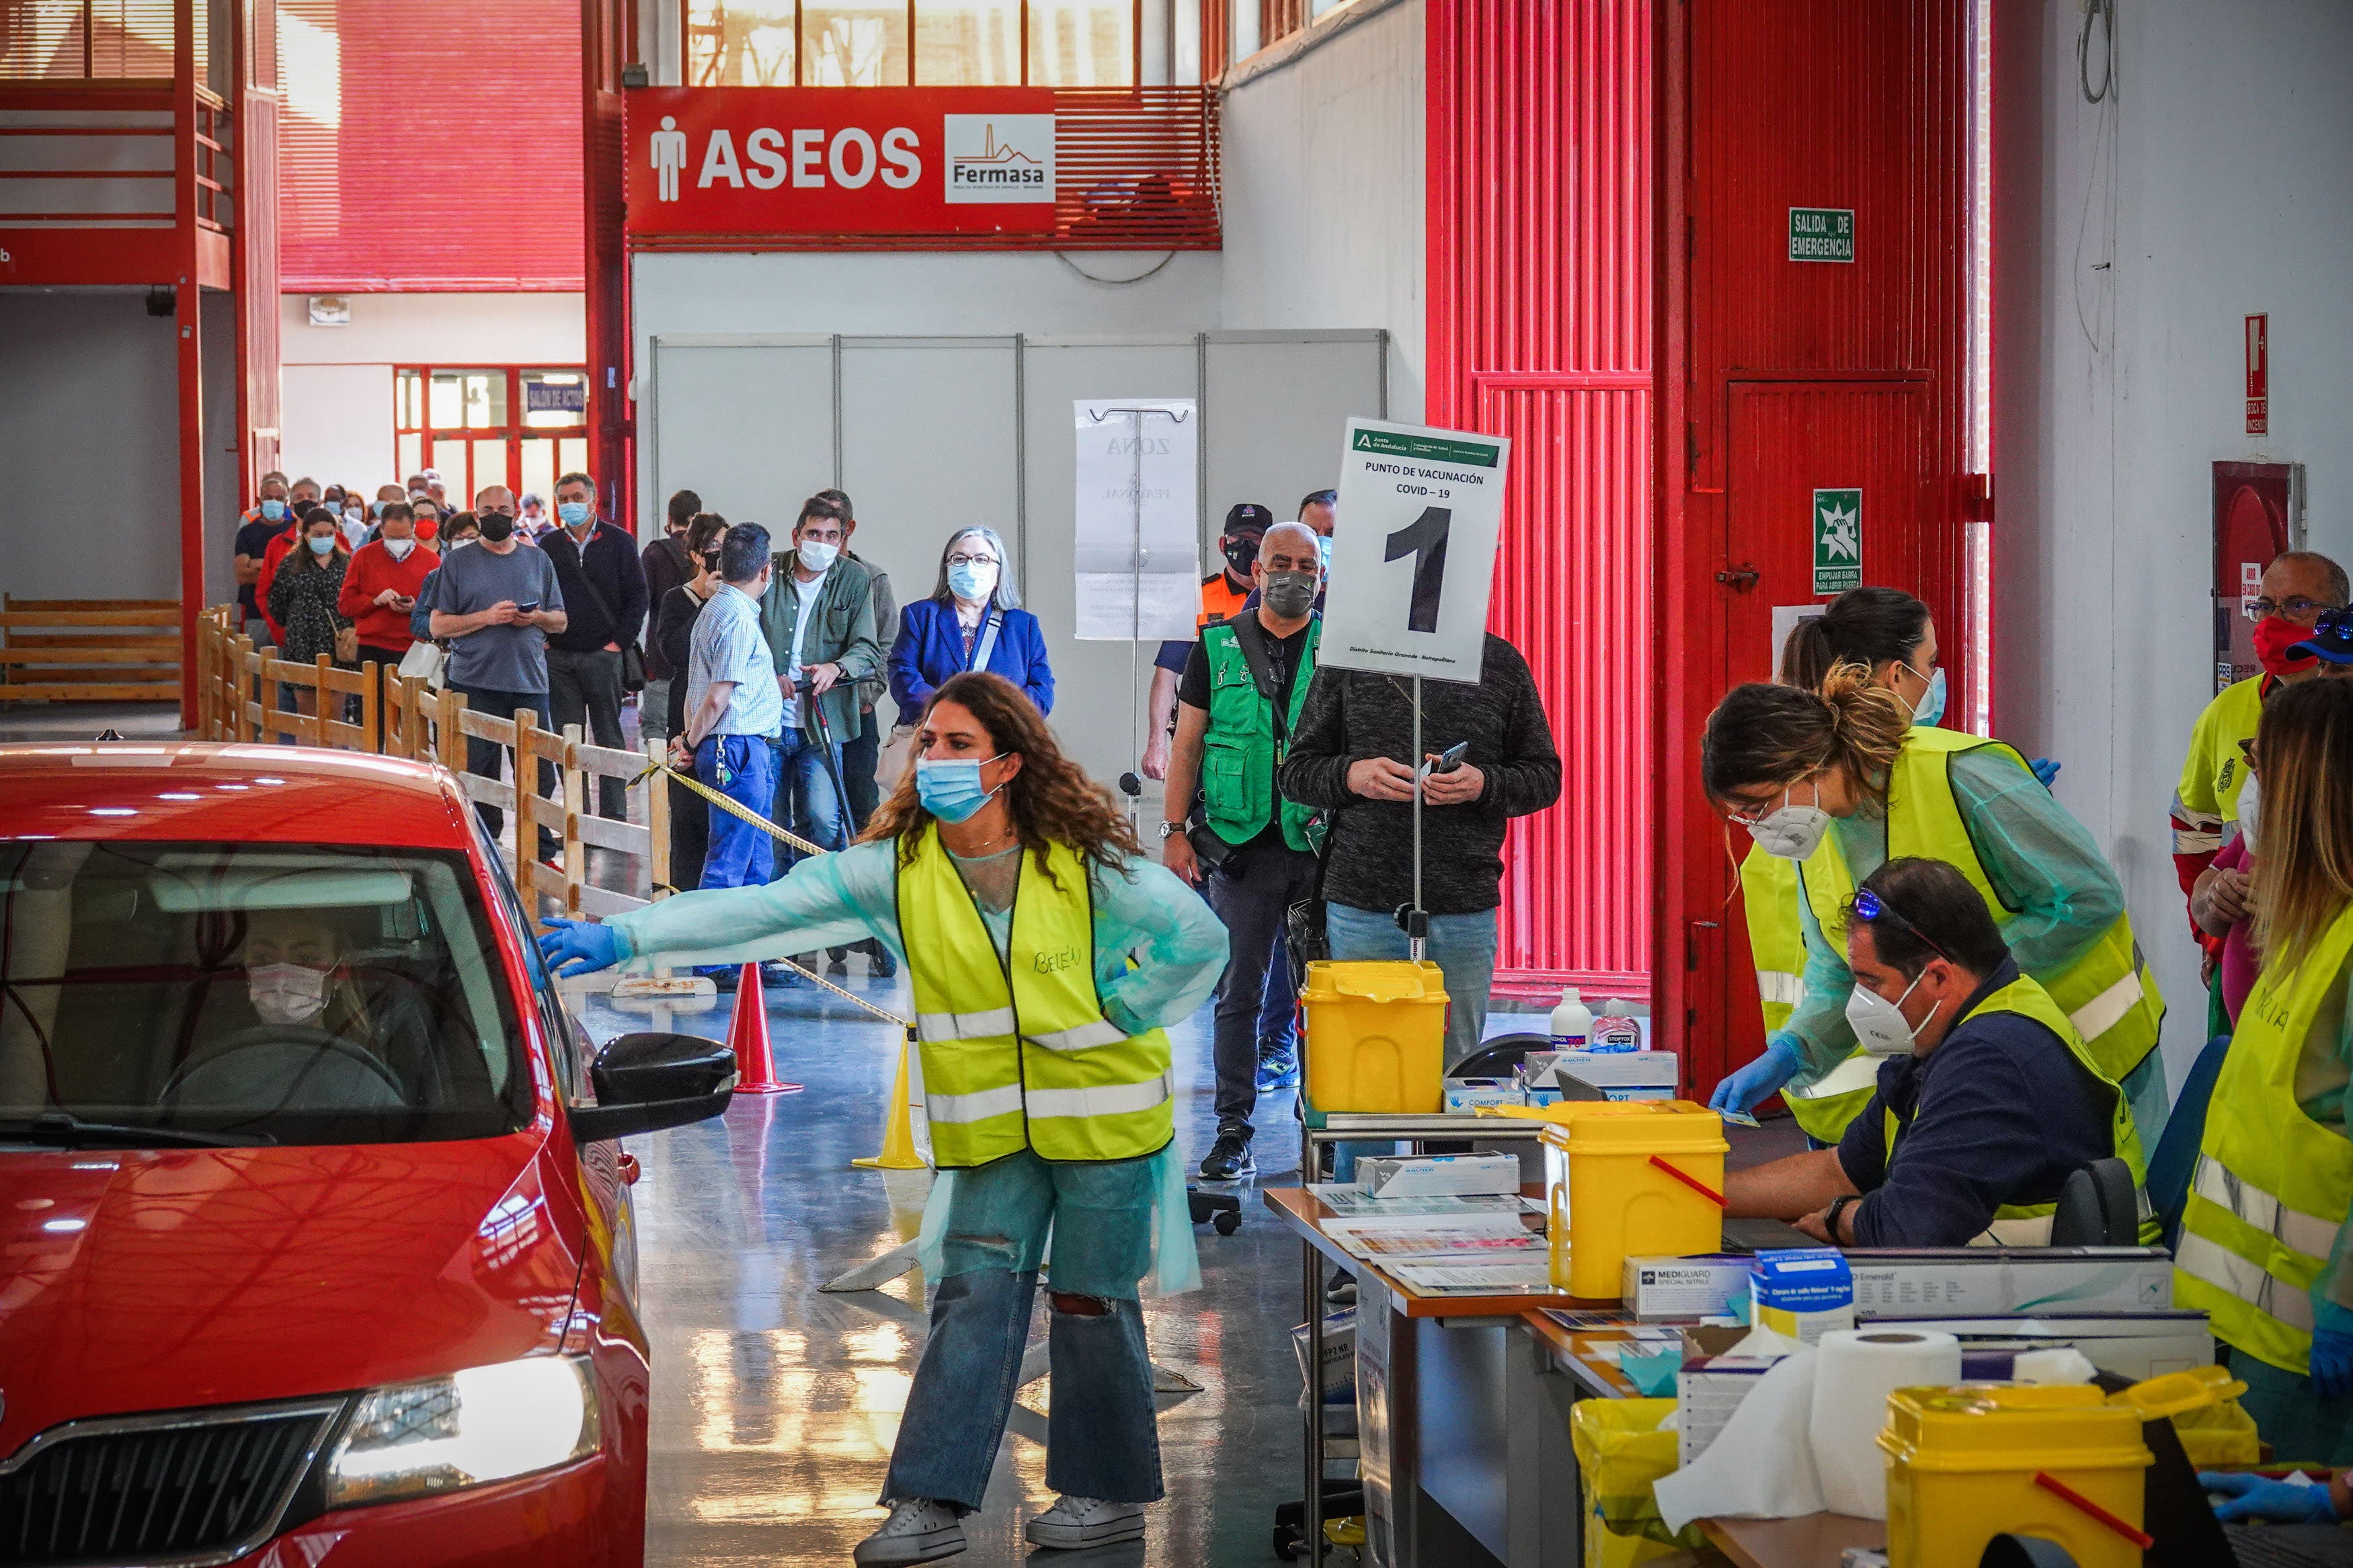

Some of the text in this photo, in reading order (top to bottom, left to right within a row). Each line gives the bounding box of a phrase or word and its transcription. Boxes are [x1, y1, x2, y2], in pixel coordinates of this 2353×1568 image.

[697, 128, 922, 189] ASEOS
[954, 165, 1043, 182] Fermasa
[1795, 214, 1849, 233] SALIDA DE
[1792, 237, 1851, 256] EMERGENCIA
[2247, 403, 2266, 414] BOCA DE
[1380, 443, 1407, 451] Andalucía
[1365, 462, 1484, 485] PUNTO DE VACUNACIÓN
[1396, 484, 1427, 495] COVID
[1439, 489, 1450, 498] 19
[1384, 506, 1451, 634] 1
[1819, 571, 1858, 581] EMPUJAR BARRA
[1817, 582, 1827, 590] PARA
[1829, 581, 1842, 589] ABRIR
[1421, 655, 1455, 663] Metropolitano
[1323, 1347, 1338, 1358] FP2
